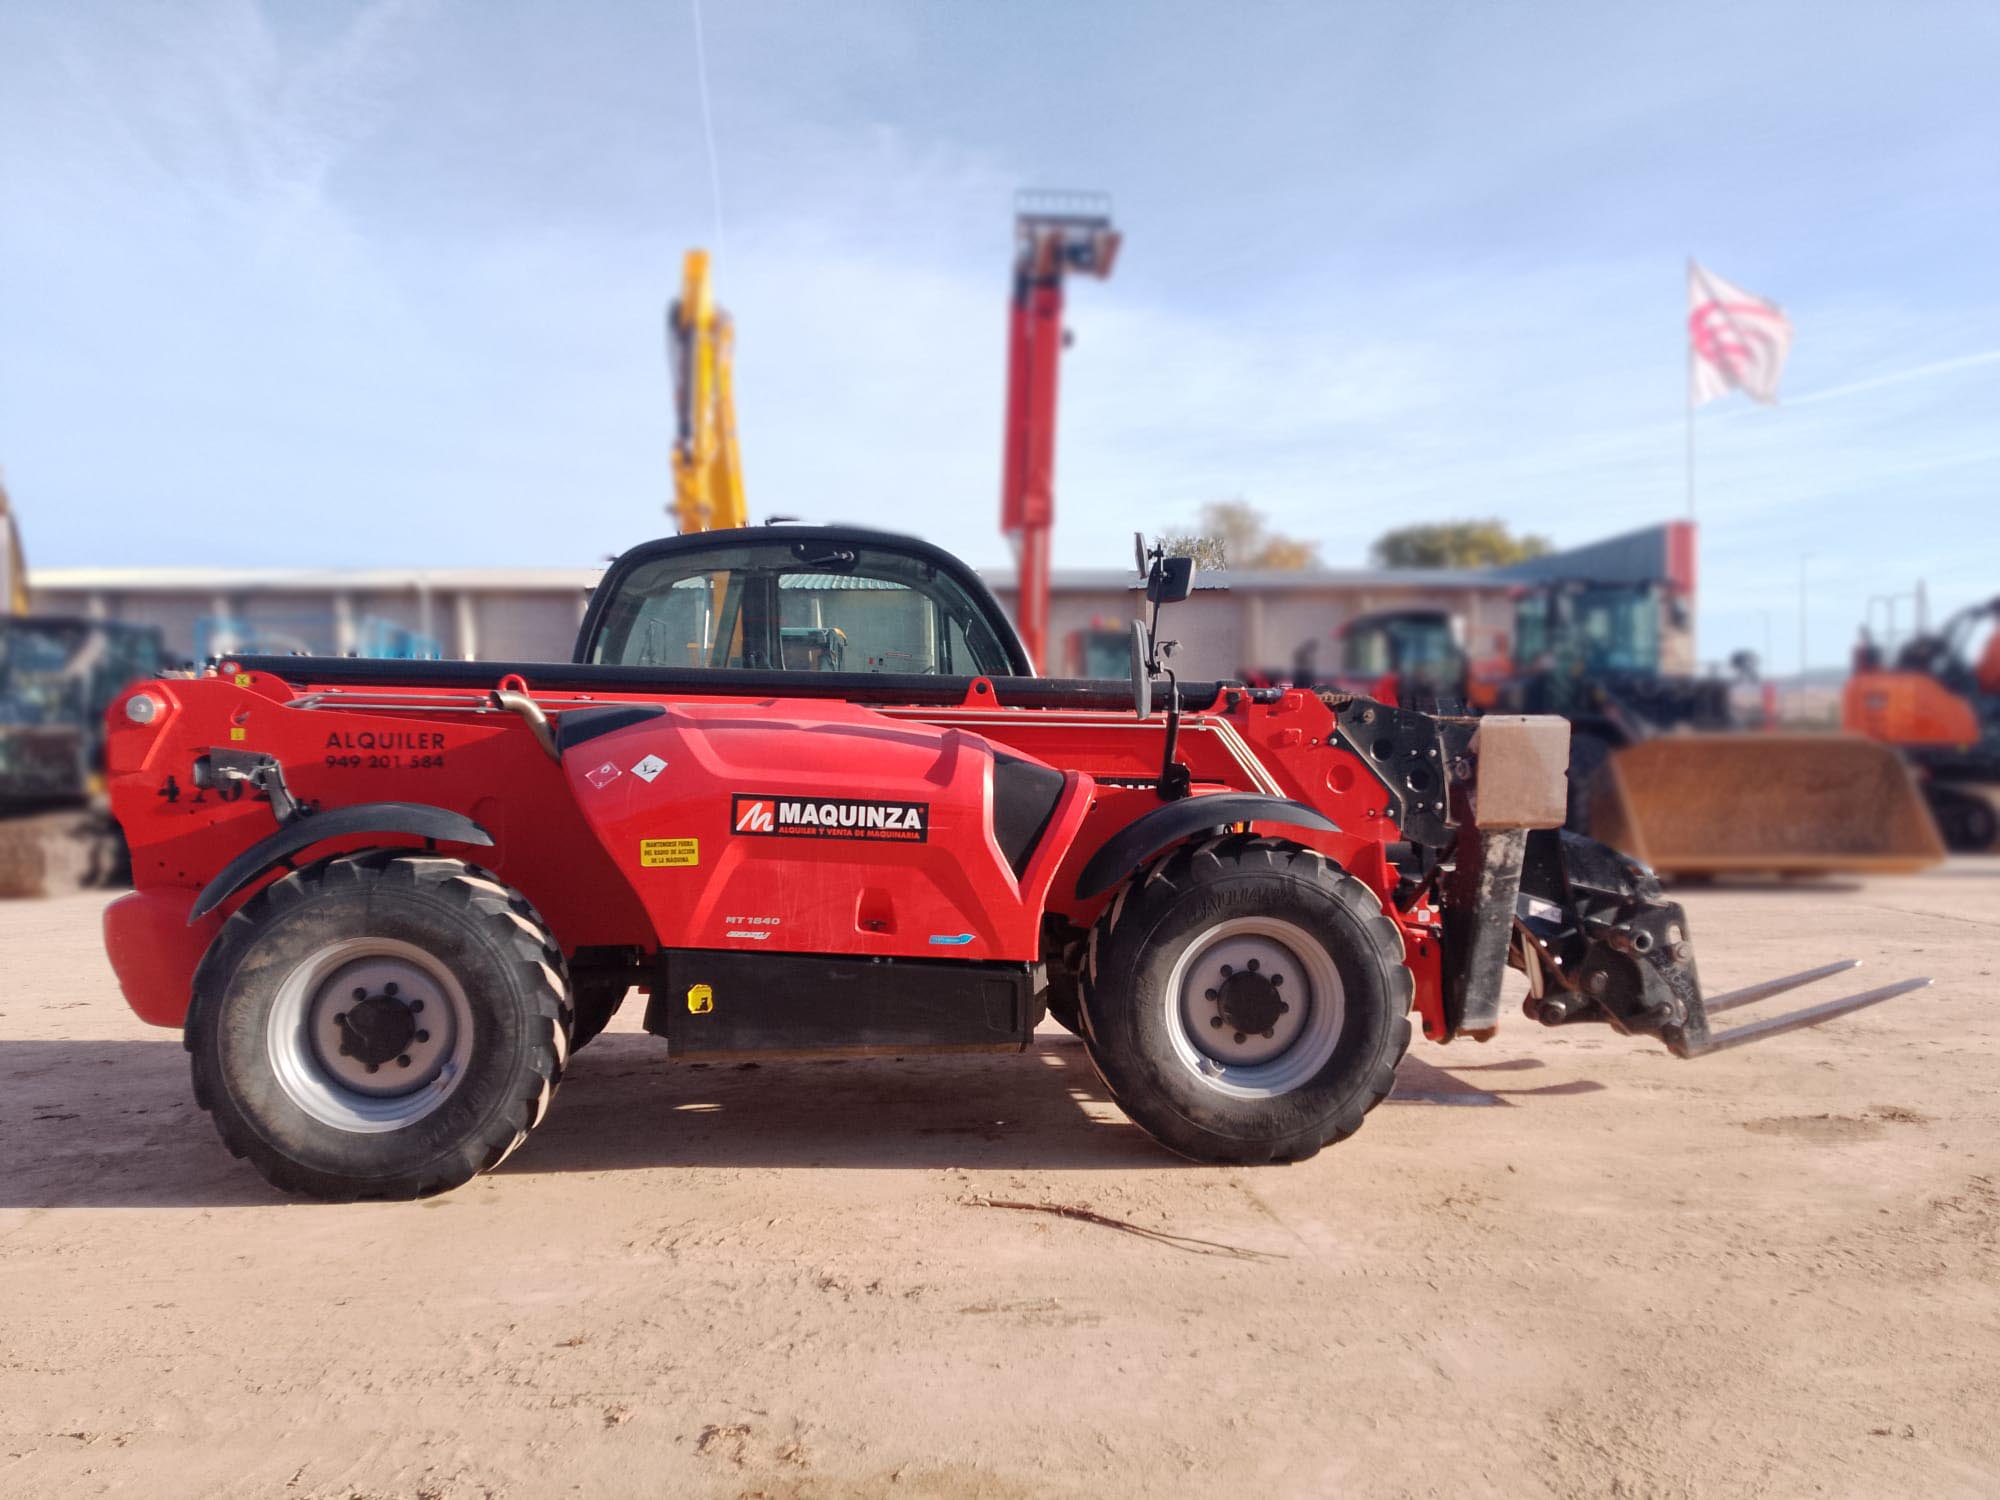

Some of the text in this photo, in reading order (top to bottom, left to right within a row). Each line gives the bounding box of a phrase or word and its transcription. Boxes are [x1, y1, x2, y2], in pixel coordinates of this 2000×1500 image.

[326, 732, 445, 749] ALQUILER
[325, 755, 361, 768] 949
[368, 755, 400, 768] 201
[778, 802, 922, 830] MAQUINZA
[778, 826, 816, 835] ALQUILER
[827, 828, 852, 837] VENTA
[867, 830, 920, 839] MAQUINARIA
[725, 916, 745, 924] MT
